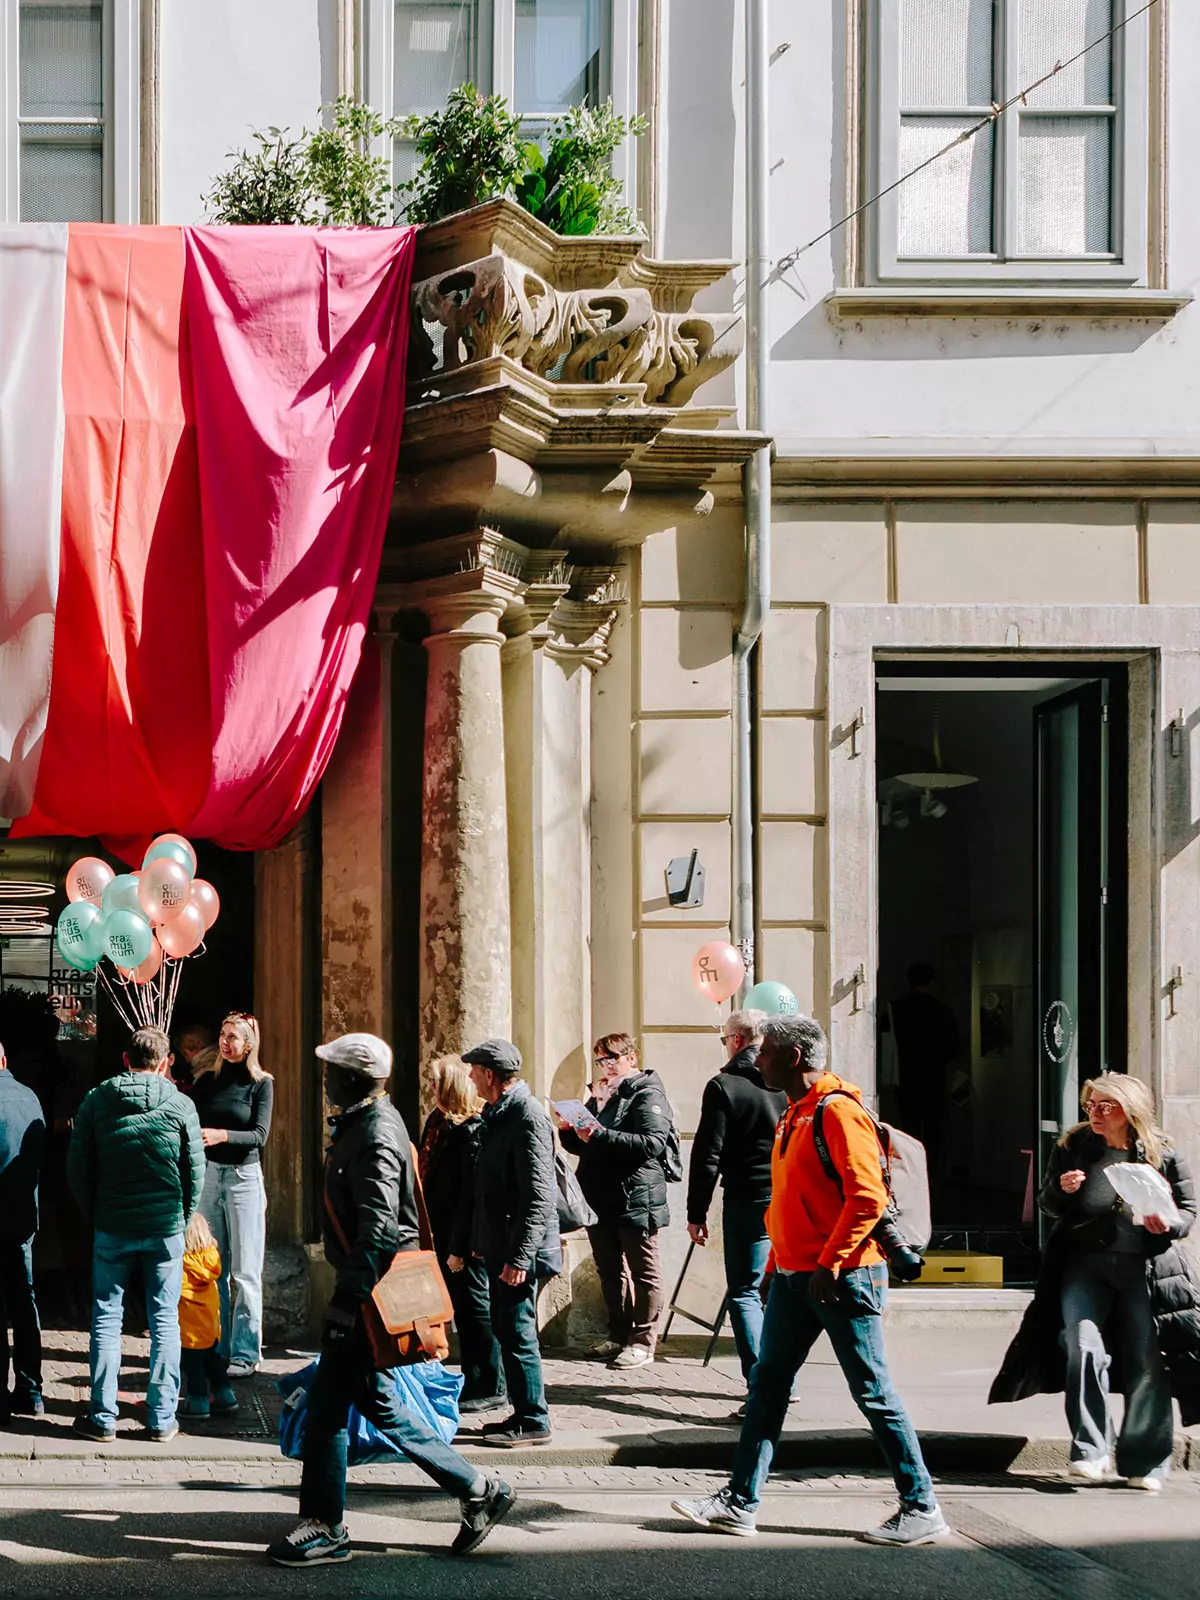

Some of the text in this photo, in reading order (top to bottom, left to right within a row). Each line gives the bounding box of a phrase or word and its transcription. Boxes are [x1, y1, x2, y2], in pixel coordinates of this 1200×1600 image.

[109, 934, 132, 943] graz
[110, 942, 134, 950] mus
[111, 949, 135, 957] eum
[50, 982, 93, 995] mus
